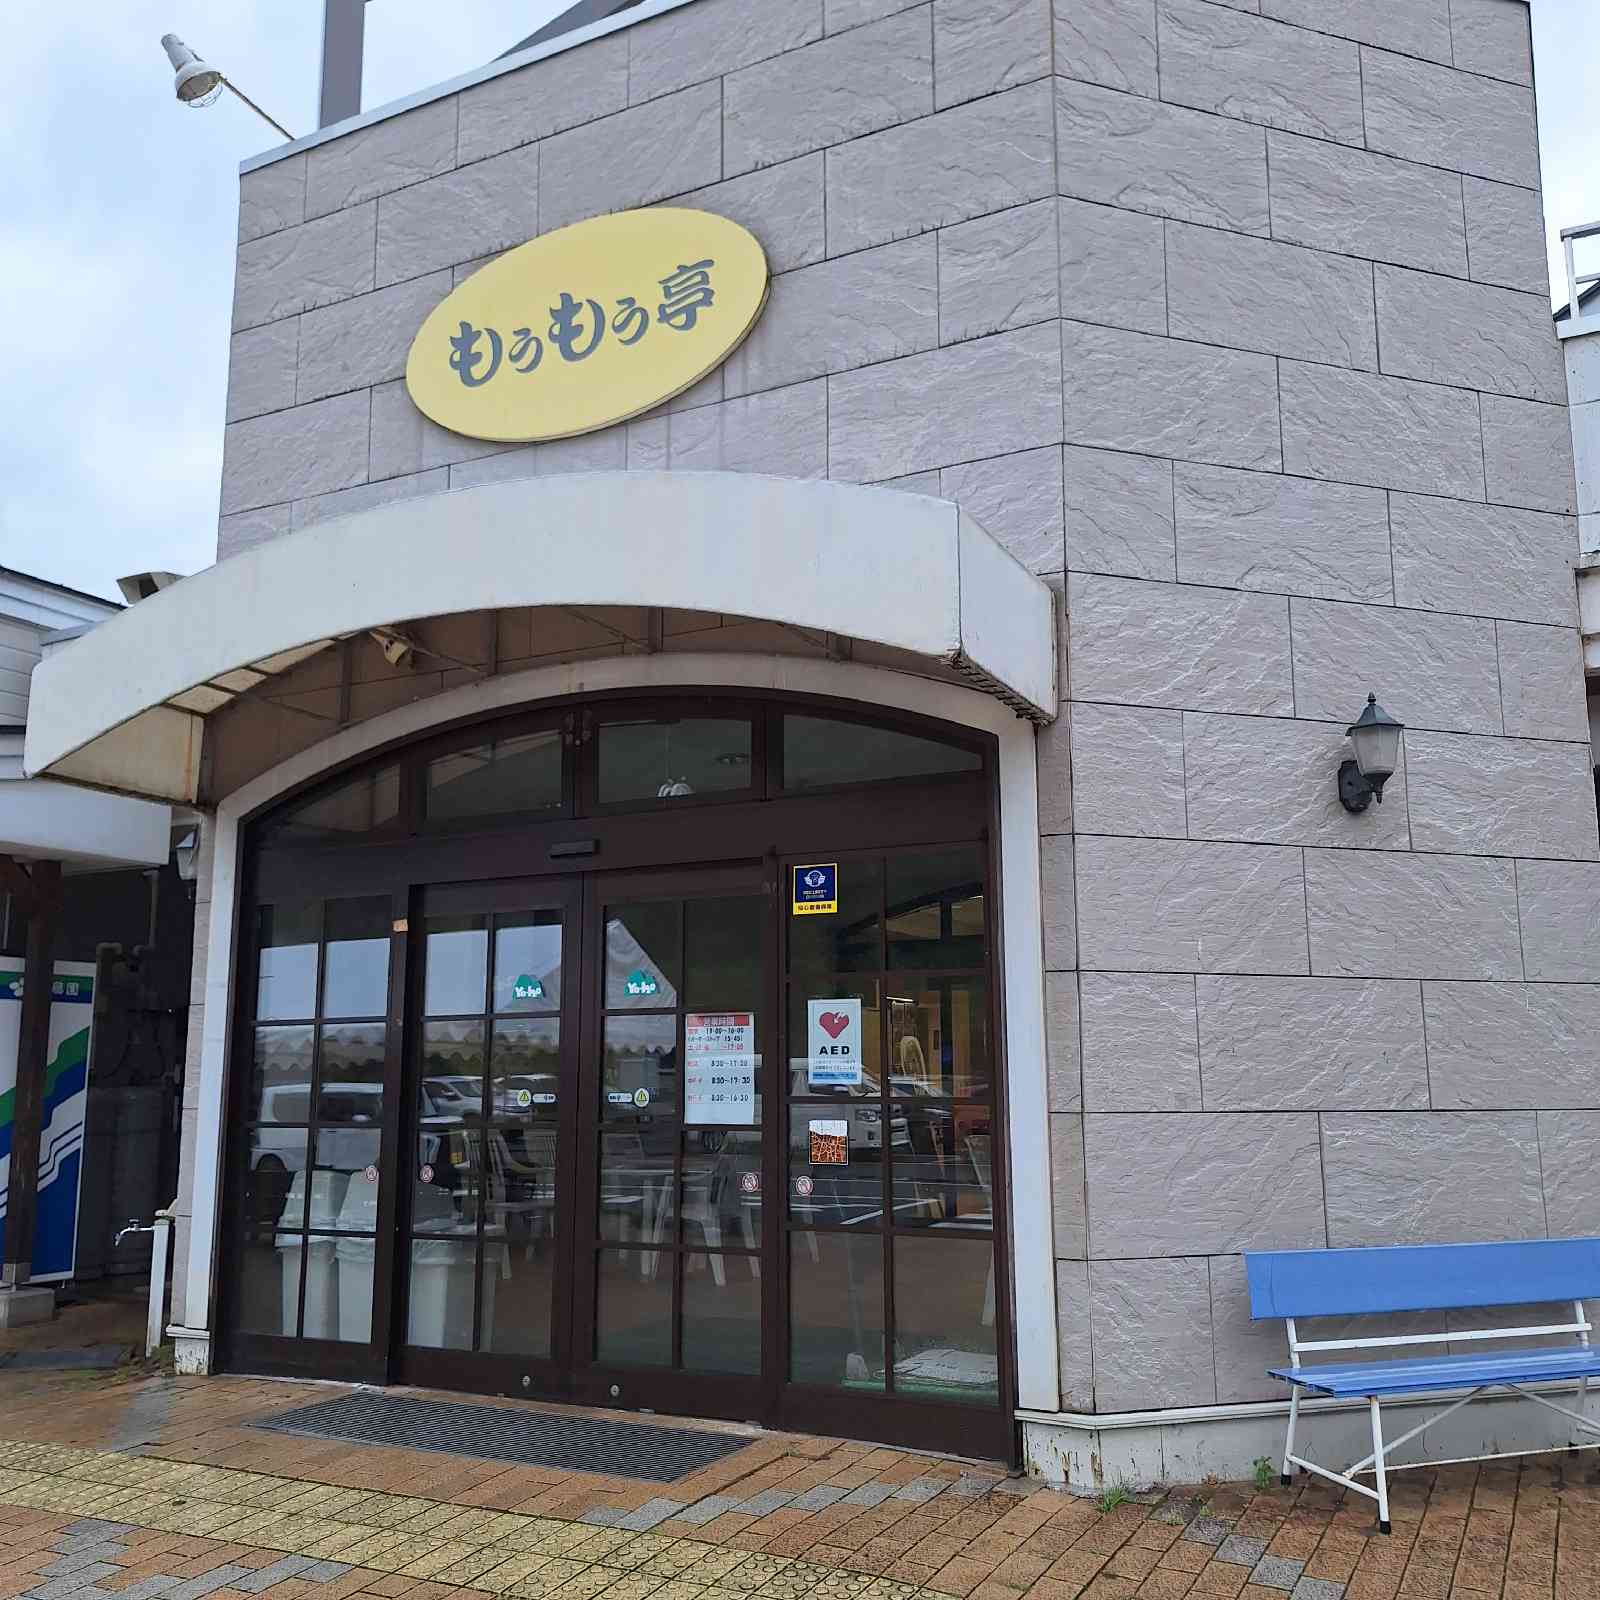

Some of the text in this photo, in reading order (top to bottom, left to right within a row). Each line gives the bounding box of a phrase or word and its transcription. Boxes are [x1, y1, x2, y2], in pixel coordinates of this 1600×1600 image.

[449, 258, 714, 388] もうもう亭
[819, 1046, 850, 1055] AED
